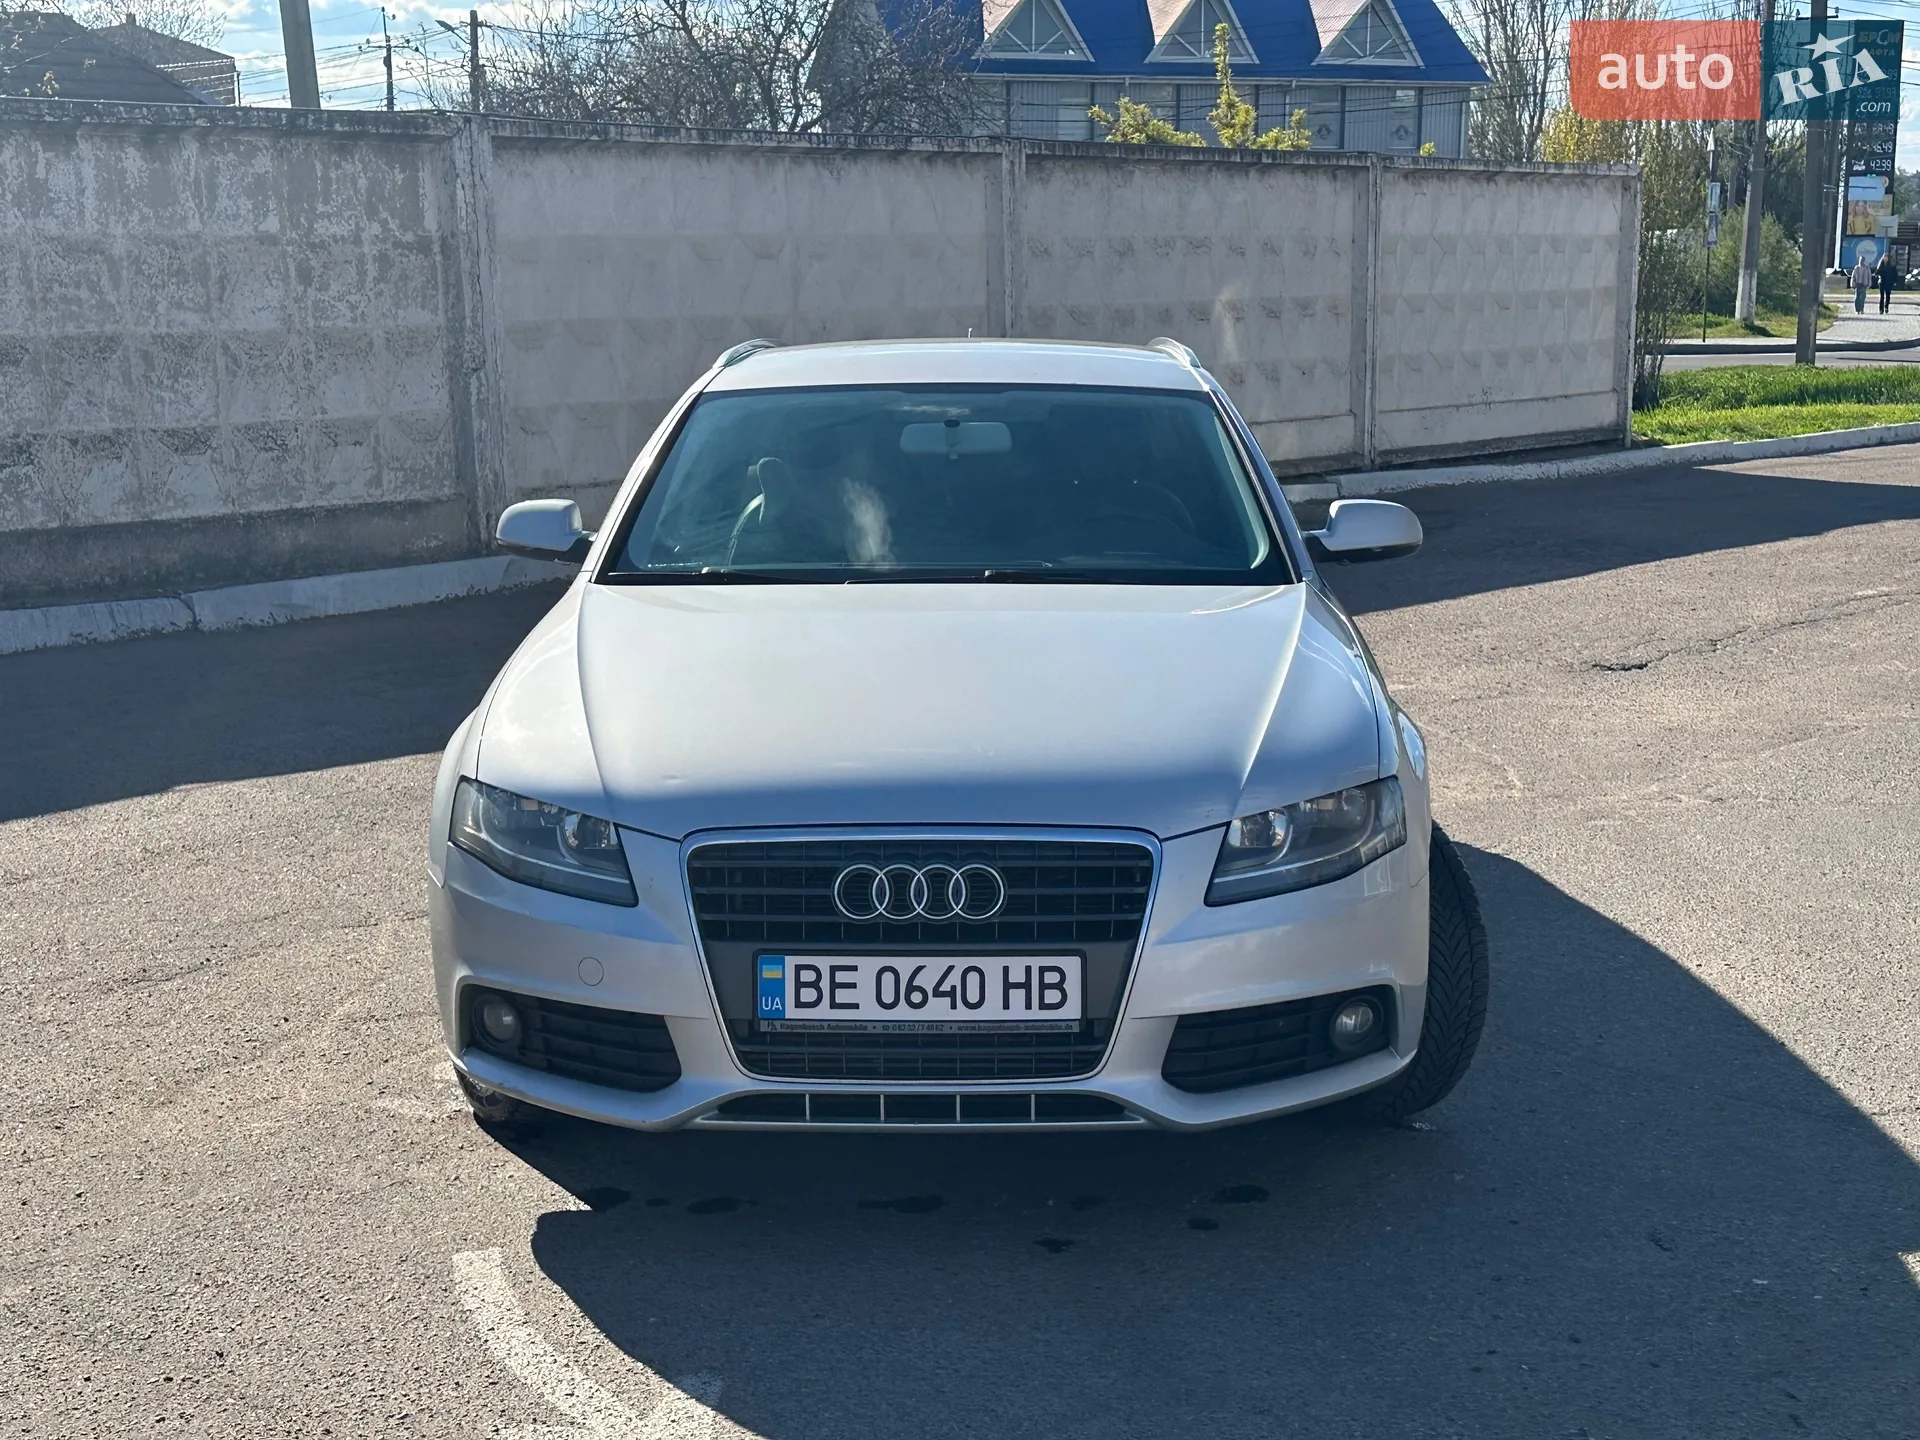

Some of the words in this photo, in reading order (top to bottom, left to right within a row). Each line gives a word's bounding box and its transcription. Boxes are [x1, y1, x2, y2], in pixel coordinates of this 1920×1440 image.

[794, 964, 860, 1009] BE
[875, 964, 986, 1011] 0640
[1002, 965, 1068, 1010] HB
[762, 997, 782, 1011] UA
